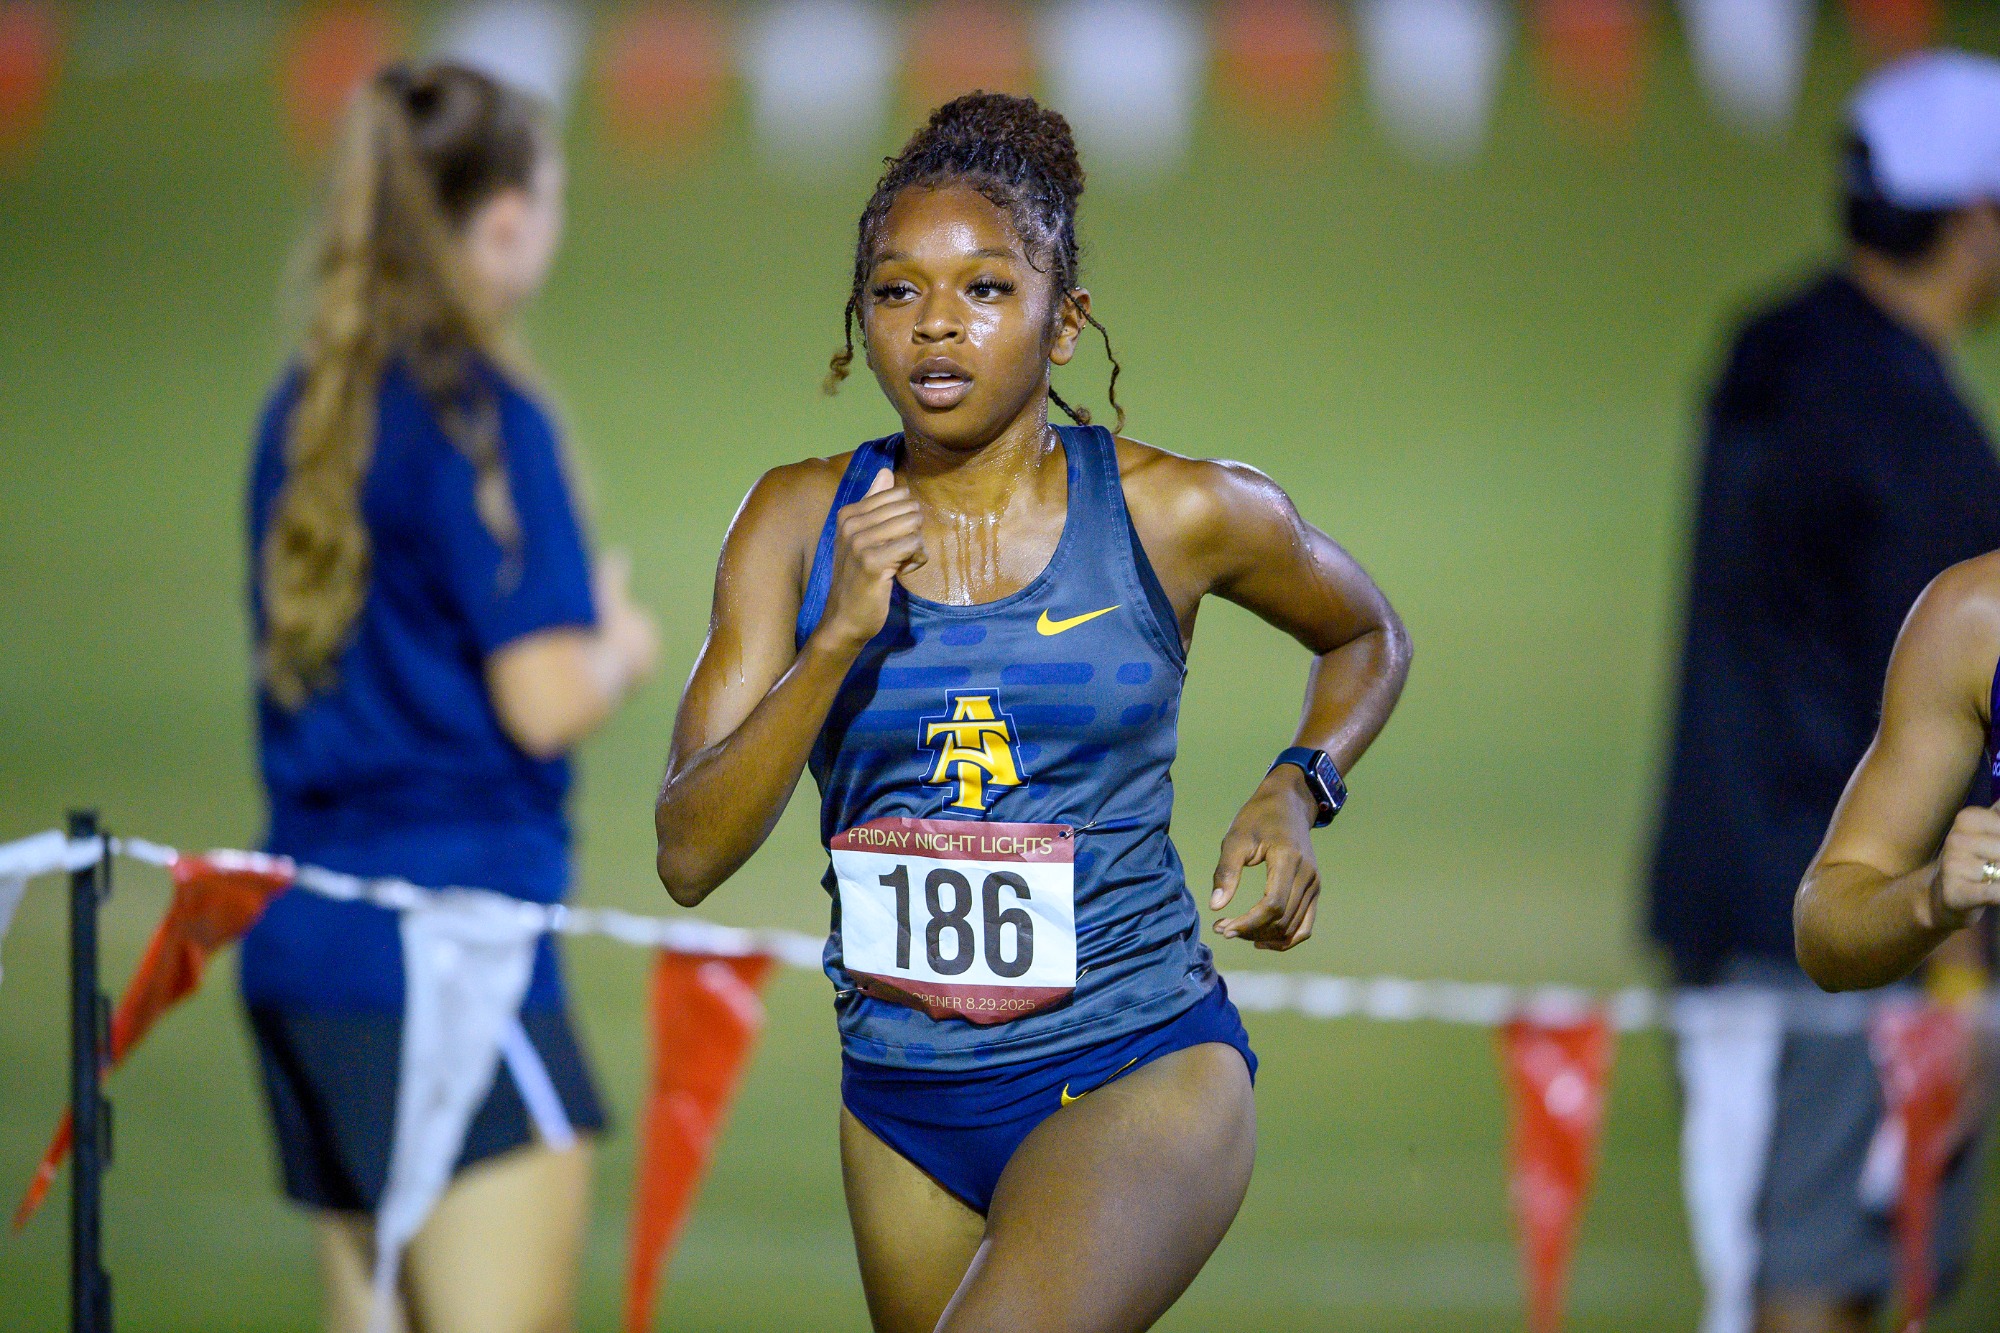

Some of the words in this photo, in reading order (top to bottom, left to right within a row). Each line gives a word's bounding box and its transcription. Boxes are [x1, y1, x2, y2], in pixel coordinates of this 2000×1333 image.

[848, 827, 910, 848] FRIDAY
[915, 832, 976, 852] NIGHT
[981, 836, 1053, 855] LIGHTS
[878, 864, 1034, 978] 186
[966, 997, 1036, 1011] 8.29.2025
